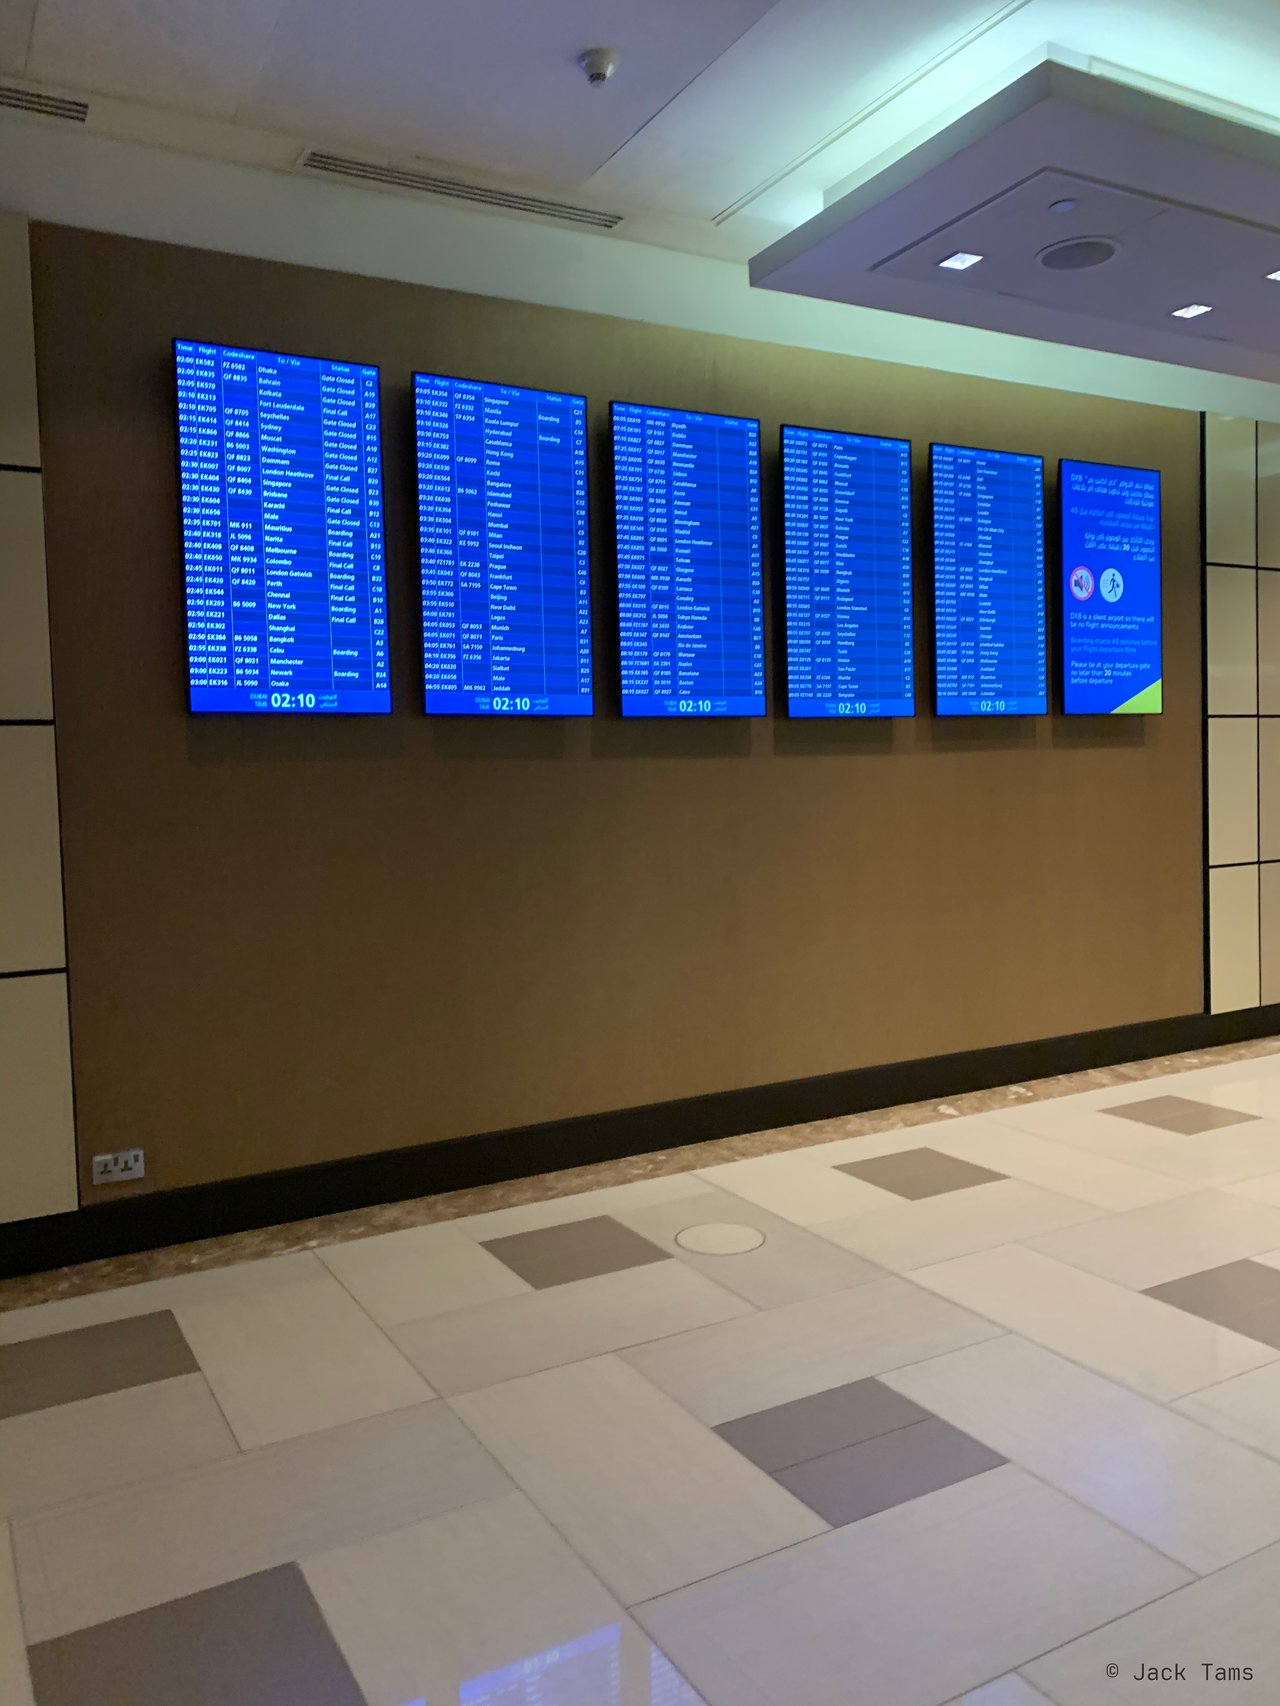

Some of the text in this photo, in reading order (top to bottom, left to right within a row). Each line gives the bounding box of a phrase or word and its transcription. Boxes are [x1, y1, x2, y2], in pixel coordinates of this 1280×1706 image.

[177, 343, 193, 352] Time
[198, 346, 216, 355] Flight
[222, 350, 255, 360] Codeshare
[331, 364, 350, 373] Status
[361, 368, 376, 376] Gate
[195, 358, 355, 385] EK582 Dhaka Gate Closed
[258, 377, 281, 386] Bahrain
[196, 381, 282, 398] EK570 Kolkata
[197, 392, 216, 401] EK213
[259, 400, 272, 408] Fort
[272, 402, 305, 411] Lauderdale
[322, 407, 337, 415] Final
[197, 404, 290, 421] EK705 Seychelles
[537, 414, 560, 424] Boarding
[198, 415, 357, 439] EK414 Sydney Gate Closed
[260, 434, 282, 442] Muscat
[538, 434, 561, 444] Boarding
[199, 438, 296, 455] EK231 Washington
[261, 456, 290, 465] Dammam
[262, 468, 285, 476] London
[285, 470, 314, 479] Heathrow
[325, 473, 339, 481] Final
[262, 479, 292, 488] Singapore
[263, 490, 288, 499] Brisbane
[263, 501, 286, 509] Karachi
[264, 512, 279, 520] Male
[202, 519, 353, 538] EK701 Mauritius Boarding
[264, 535, 283, 543] Narita
[328, 539, 342, 547] Final
[265, 546, 297, 555] Melbourne
[265, 557, 292, 566] Colombo
[204, 565, 223, 573] EK011
[289, 570, 313, 578] Gatwick
[329, 572, 355, 582] Boarding
[204, 576, 224, 584] EK420
[266, 591, 291, 599] Chennai
[205, 599, 225, 607] EK203
[331, 605, 357, 614] Boarding
[268, 613, 286, 621] Dallas
[206, 622, 296, 633] EK302 Shanghai
[269, 635, 295, 644] Bangkok
[332, 649, 358, 657] Boarding
[208, 656, 227, 664] EK021
[208, 667, 228, 675] EK223
[333, 670, 359, 679] Boarding
[271, 693, 316, 708] 02:10
[493, 697, 530, 711] 02:10
[679, 700, 711, 712] 02:10
[980, 700, 1005, 712] 02:10
[838, 702, 866, 714] 02:10
